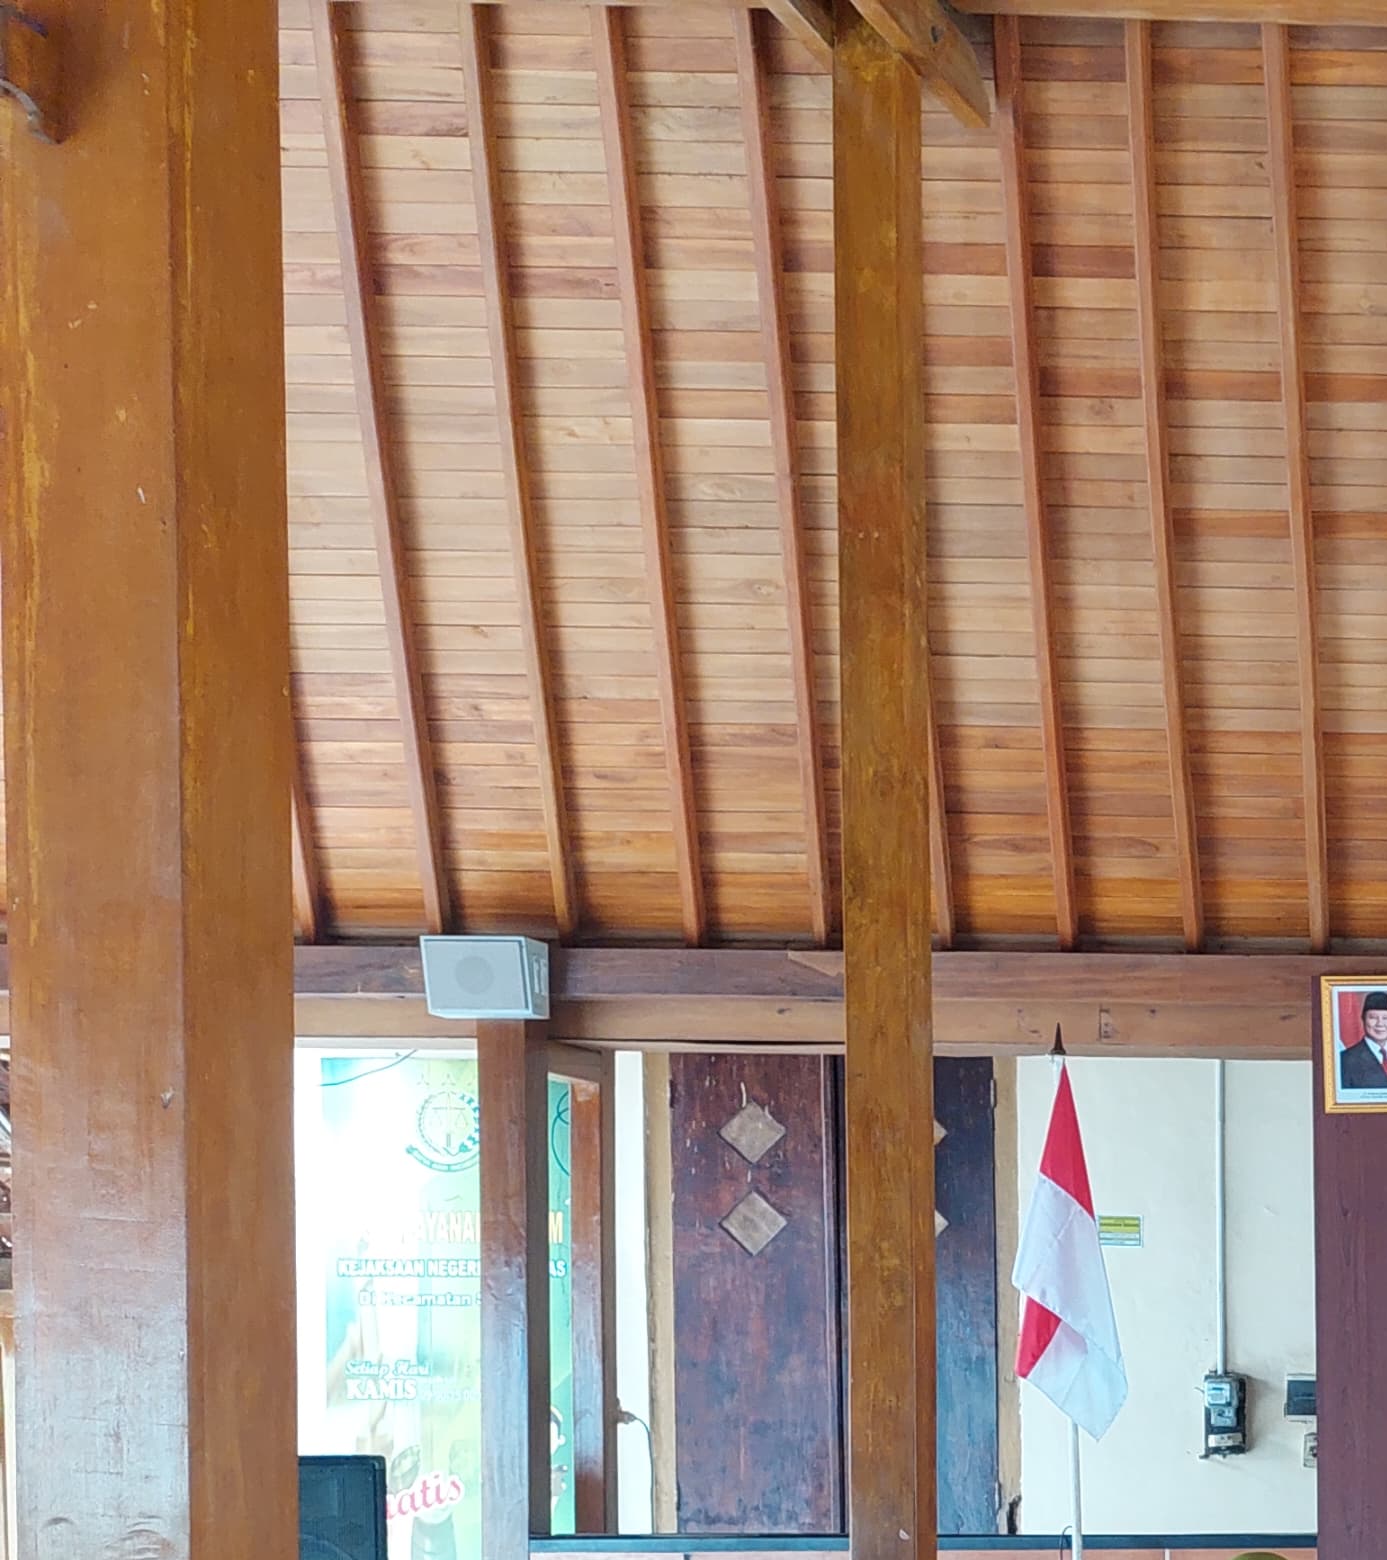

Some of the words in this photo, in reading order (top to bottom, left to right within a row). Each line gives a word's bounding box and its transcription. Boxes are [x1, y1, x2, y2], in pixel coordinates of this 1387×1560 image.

[337, 1258, 426, 1279] KEJAKSAAN
[346, 1377, 418, 1401] KAMIS
[387, 1473, 462, 1521] atis
